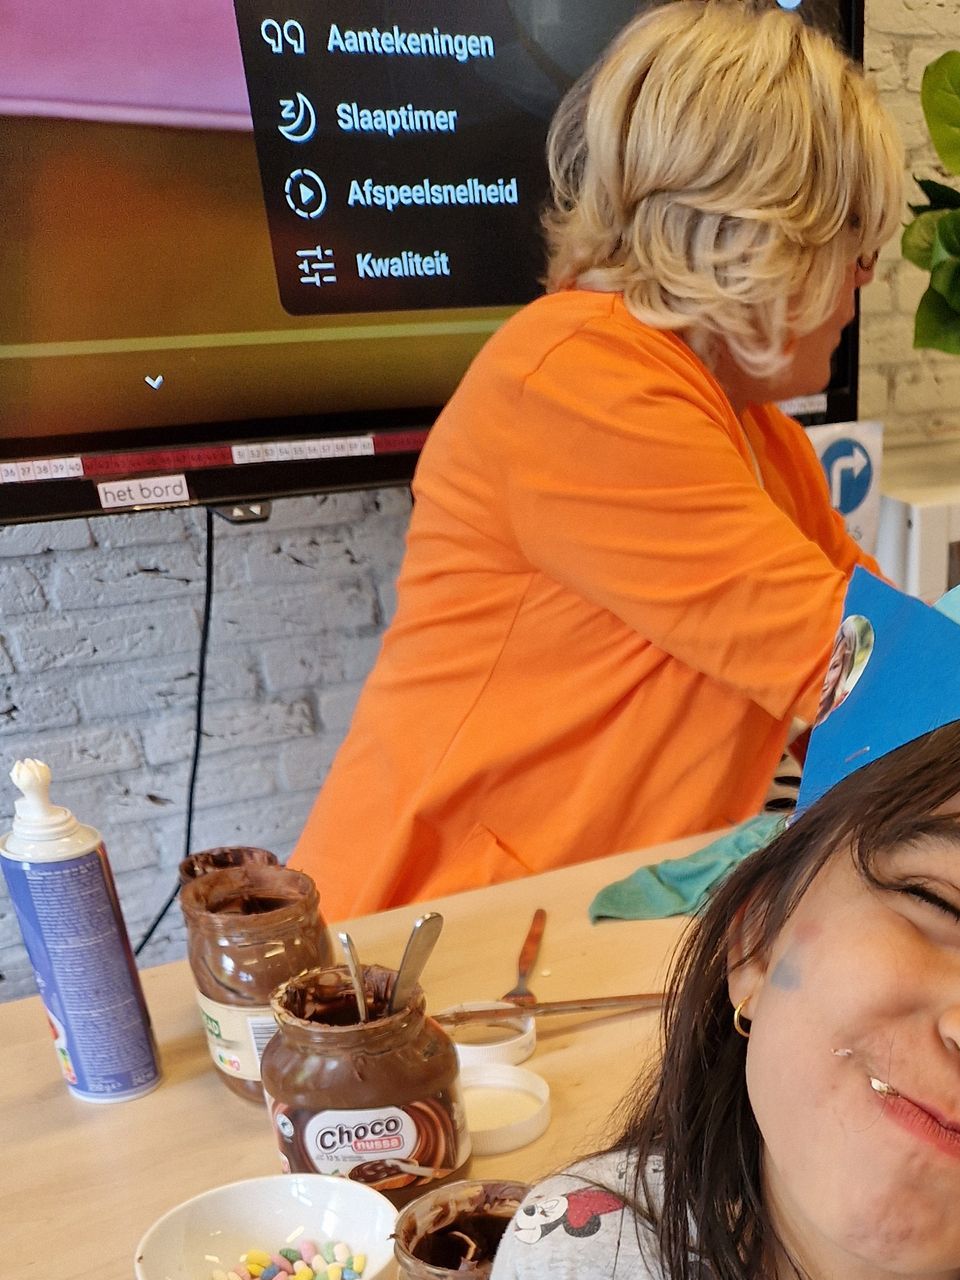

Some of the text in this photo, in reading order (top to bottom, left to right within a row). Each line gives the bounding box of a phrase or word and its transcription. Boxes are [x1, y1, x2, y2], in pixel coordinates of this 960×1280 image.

[327, 23, 495, 61] Aantekeningen
[336, 102, 458, 137] Slaaptimer
[347, 178, 519, 211] Afspeelsnelheid
[356, 251, 450, 278] Kwaliteit
[103, 479, 184, 502] het bord
[318, 1117, 402, 1151] Choco
[356, 1138, 399, 1150] nussa
